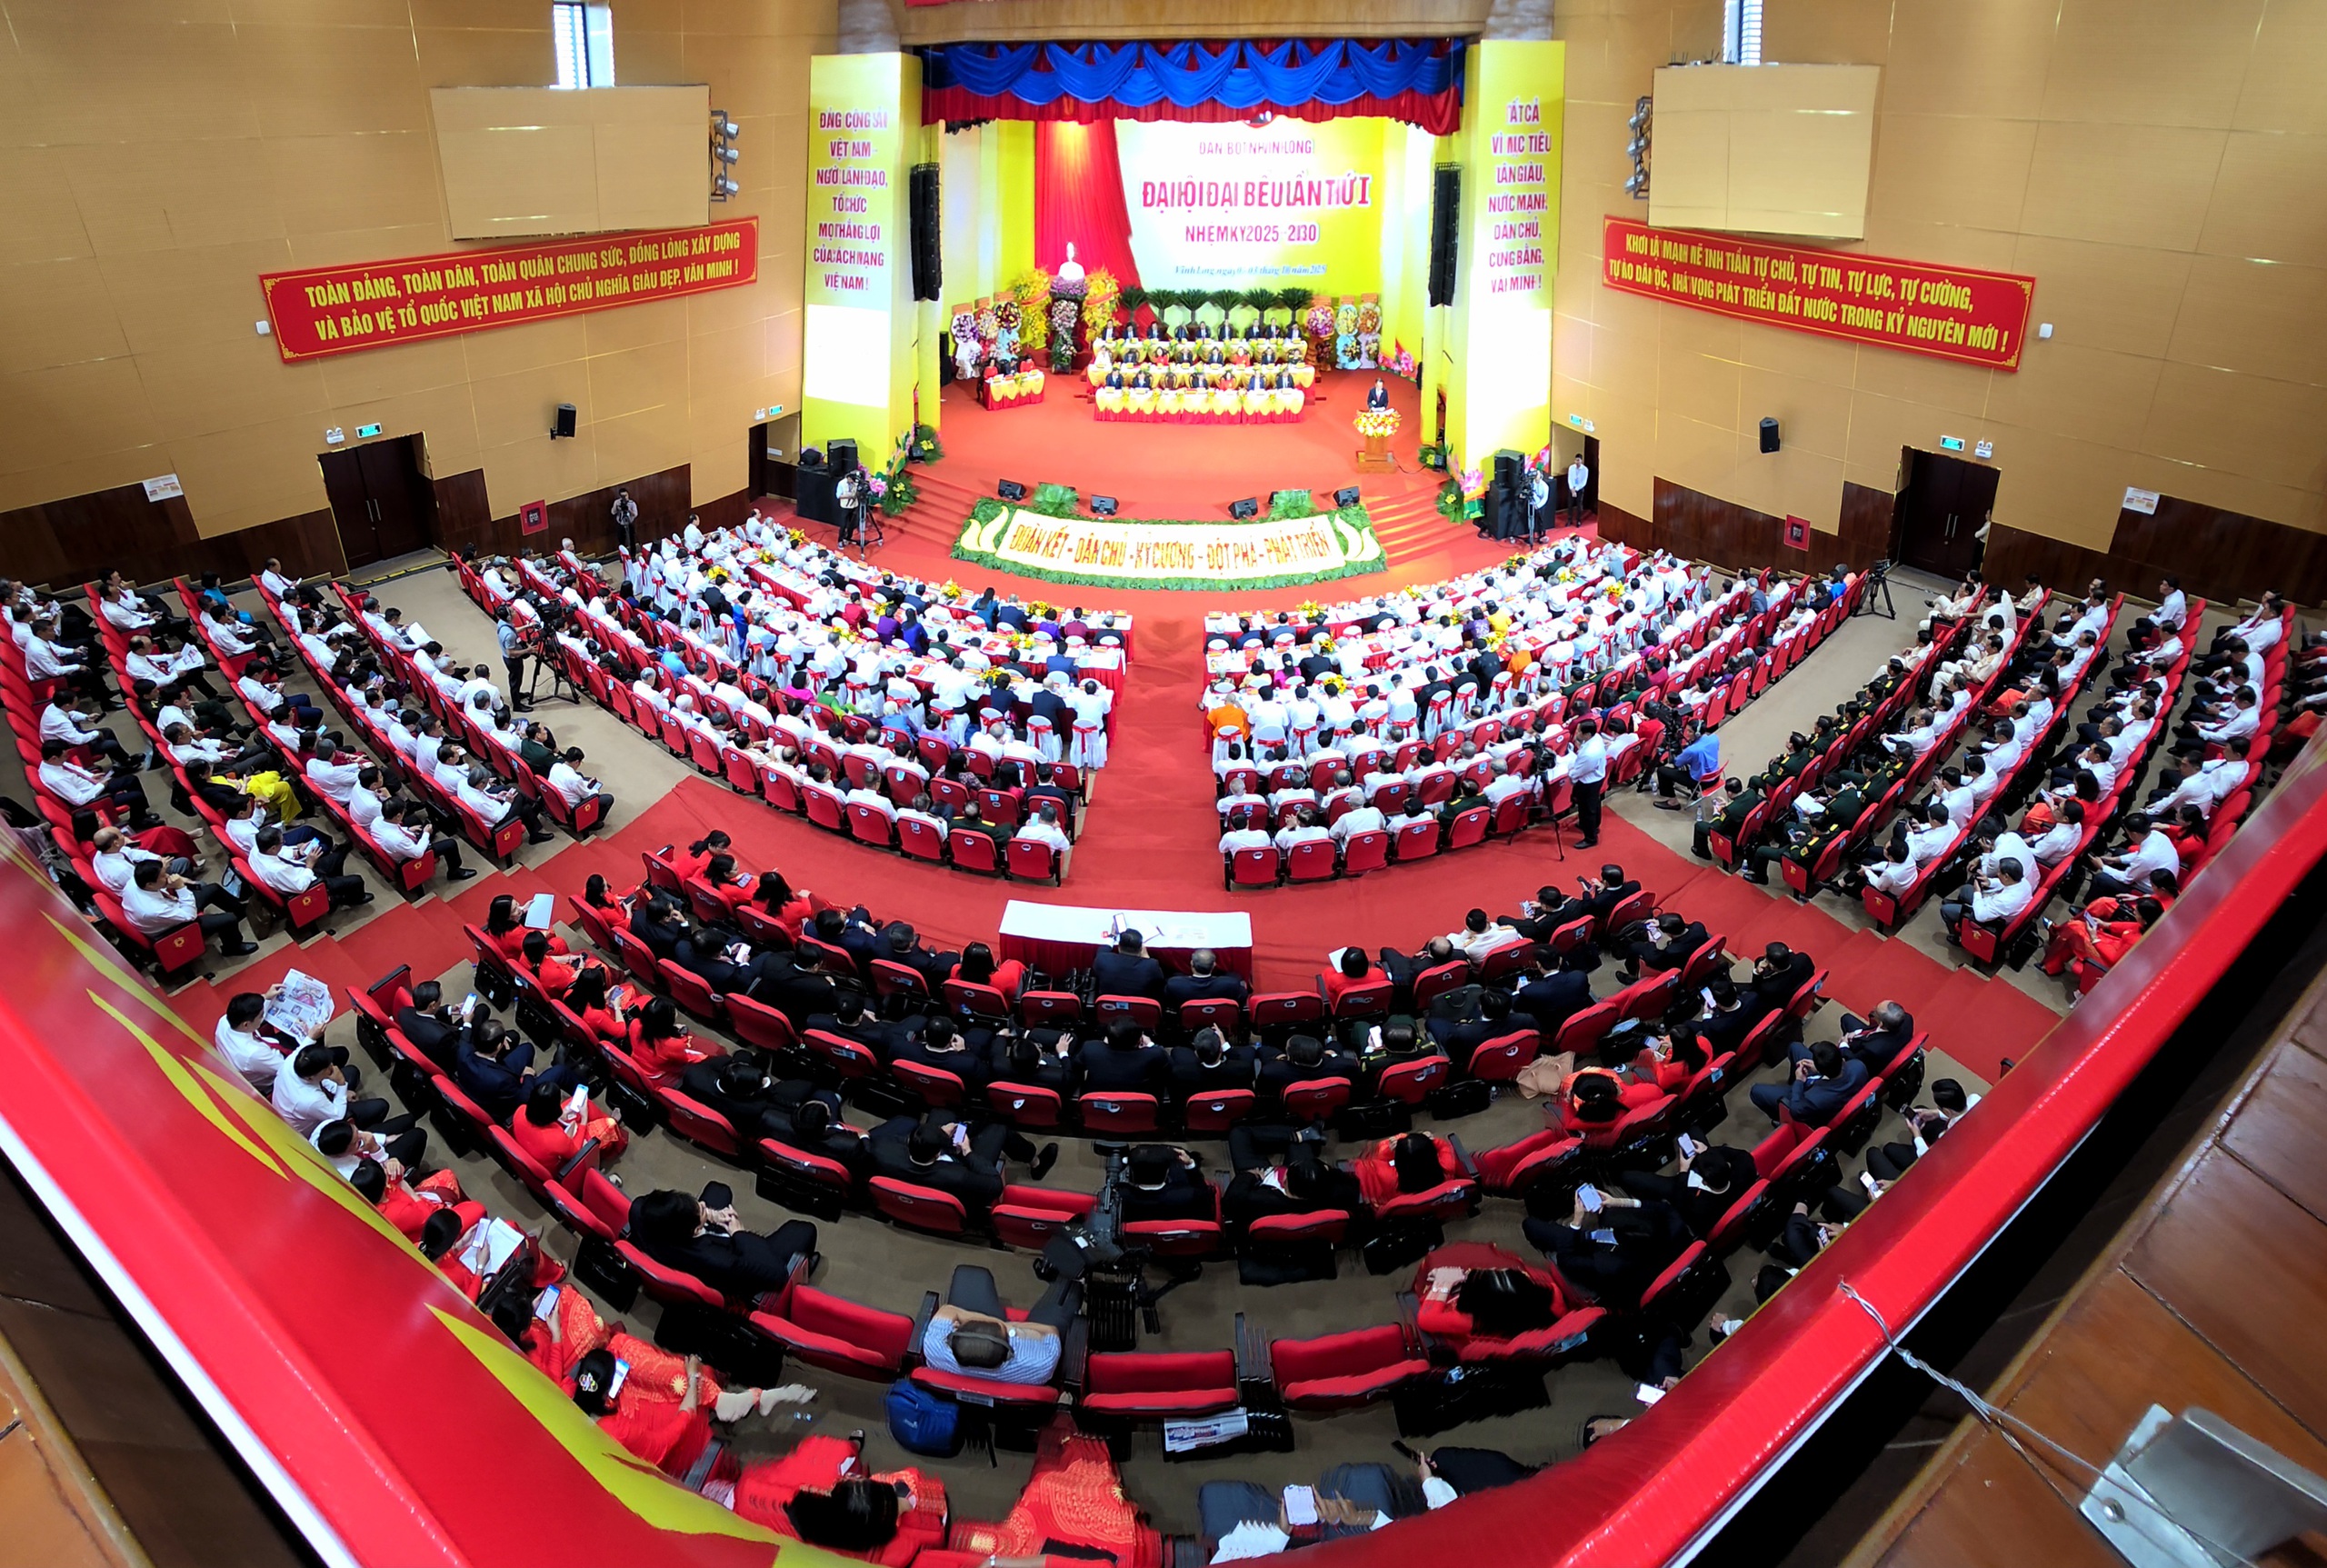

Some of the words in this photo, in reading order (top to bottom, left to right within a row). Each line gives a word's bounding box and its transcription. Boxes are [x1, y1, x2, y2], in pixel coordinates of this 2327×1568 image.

[1528, 131, 1552, 153] TIÊU
[1143, 181, 1175, 214] ĐẠI
[1206, 182, 1238, 214] ĐẠI
[1358, 176, 1370, 205] I
[1245, 225, 1279, 242] 2025
[305, 280, 351, 308] TOÀN
[352, 273, 402, 302] ĐẢNG,
[403, 267, 443, 295] TOÀN
[444, 264, 480, 289] DÂN,
[481, 259, 517, 284] TOÀN
[519, 254, 554, 281] QUÂN
[557, 252, 598, 274] CHUNG
[600, 245, 627, 268] SỨC,
[629, 239, 659, 265] ĐỒNG
[661, 236, 689, 260] LÒNG
[691, 234, 711, 255] XÂY
[713, 232, 740, 255] DỰNG
[841, 275, 864, 291] NAM
[1753, 255, 1769, 282] TỰ
[1770, 255, 1798, 285] CHỦ,
[1802, 263, 1819, 290] TỰ
[1820, 265, 1843, 293] TIN,
[1847, 270, 1866, 297] TỰ
[1866, 273, 1895, 301] LỰC,
[1900, 277, 1920, 306] TỰ
[1920, 278, 1973, 314] CƯỜNG,
[314, 315, 340, 341] VÀ
[340, 308, 374, 337] BẢO
[375, 305, 396, 335] VỆ
[397, 299, 417, 328] TỔ
[419, 295, 458, 326] QUỐC
[460, 293, 489, 320] VIỆT
[492, 291, 524, 314] NAM
[525, 285, 544, 308] XÃ
[544, 282, 567, 308] HỘI
[569, 275, 593, 302] CHỦ
[595, 274, 630, 298] NGHĨA
[632, 269, 657, 292] GIÀU
[660, 268, 682, 289] ĐẸP,
[684, 263, 704, 284] VĂN
[706, 259, 733, 280] MINH
[1743, 283, 1775, 311] TRIỂN
[1777, 288, 1802, 315] ĐẤT
[1803, 296, 1838, 323] NƯỚC
[1841, 304, 1883, 331] TRONG
[1885, 306, 1905, 335] KỶ
[1907, 315, 1965, 345] NGUYÊN
[1967, 323, 1999, 351] MỚI
[1009, 523, 1047, 554] ĐOÀN
[1042, 524, 1070, 559] KẾT
[1074, 533, 1102, 564] DÂN
